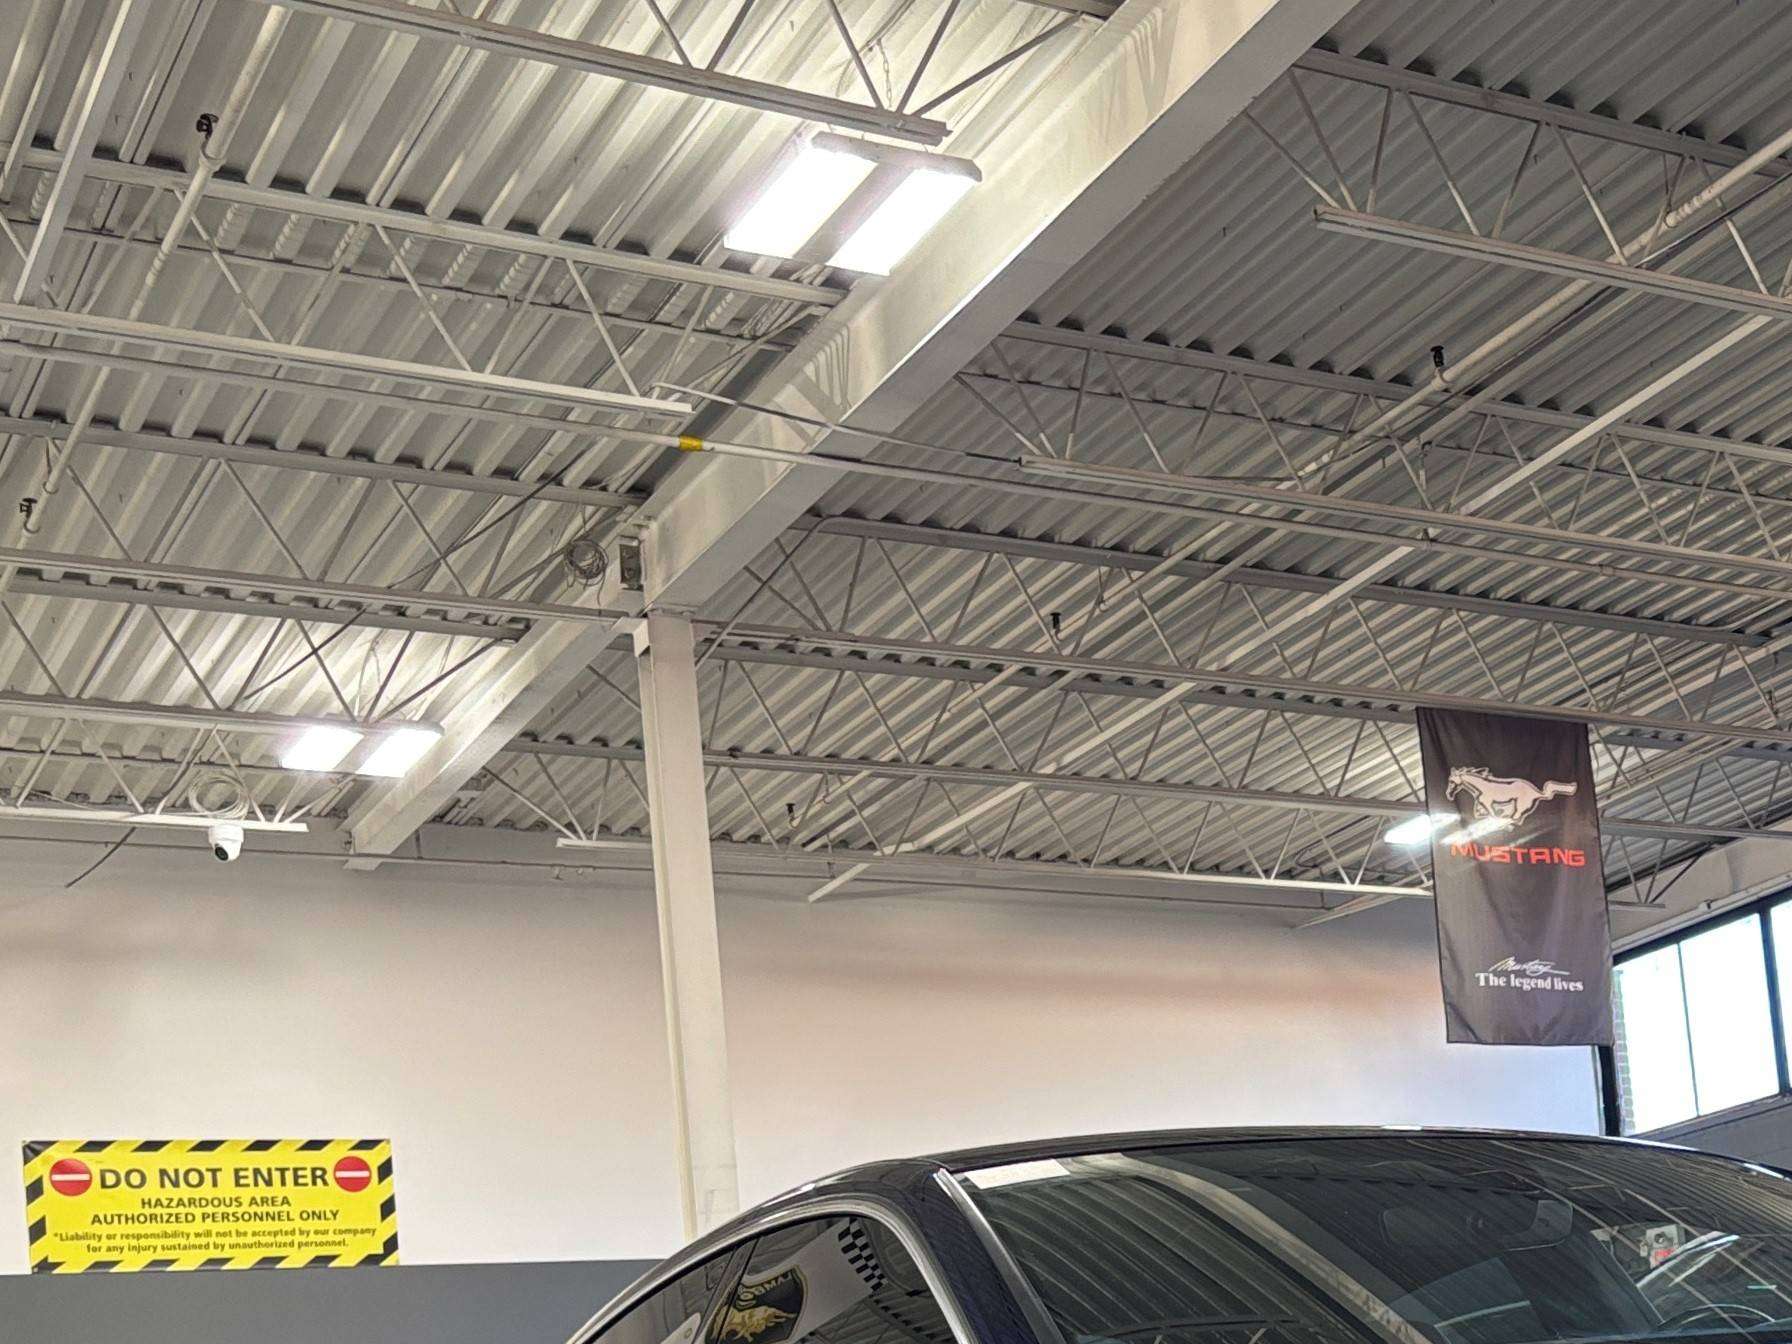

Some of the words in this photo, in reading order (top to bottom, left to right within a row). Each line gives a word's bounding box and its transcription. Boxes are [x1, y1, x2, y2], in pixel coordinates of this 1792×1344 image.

[1450, 840, 1585, 867] MUSTANG
[1475, 973, 1506, 987] The
[1510, 974, 1551, 991] legend
[1554, 977, 1584, 991] lives
[100, 1168, 147, 1189] DO
[159, 1167, 222, 1188] NOT
[234, 1167, 329, 1188] ENTER
[141, 1196, 243, 1209] HAZARDOUS
[248, 1196, 292, 1208] AREA
[91, 1212, 196, 1225] AUTHORIZED
[202, 1211, 295, 1223] PERSONNEL
[300, 1209, 340, 1222] ONLY
[106, 1233, 117, 1241] or
[120, 1231, 192, 1242] responsibility
[194, 1230, 213, 1239] will
[216, 1229, 232, 1238] not
[236, 1228, 248, 1238] be
[251, 1228, 296, 1239] accepted
[300, 1227, 310, 1238] by
[313, 1228, 329, 1236] our
[333, 1228, 377, 1238] company
[87, 1243, 102, 1253] for
[106, 1245, 125, 1254] any
[128, 1243, 158, 1254] injury
[161, 1242, 210, 1251] sustained
[213, 1241, 225, 1250] by
[229, 1240, 295, 1250] unauthorized
